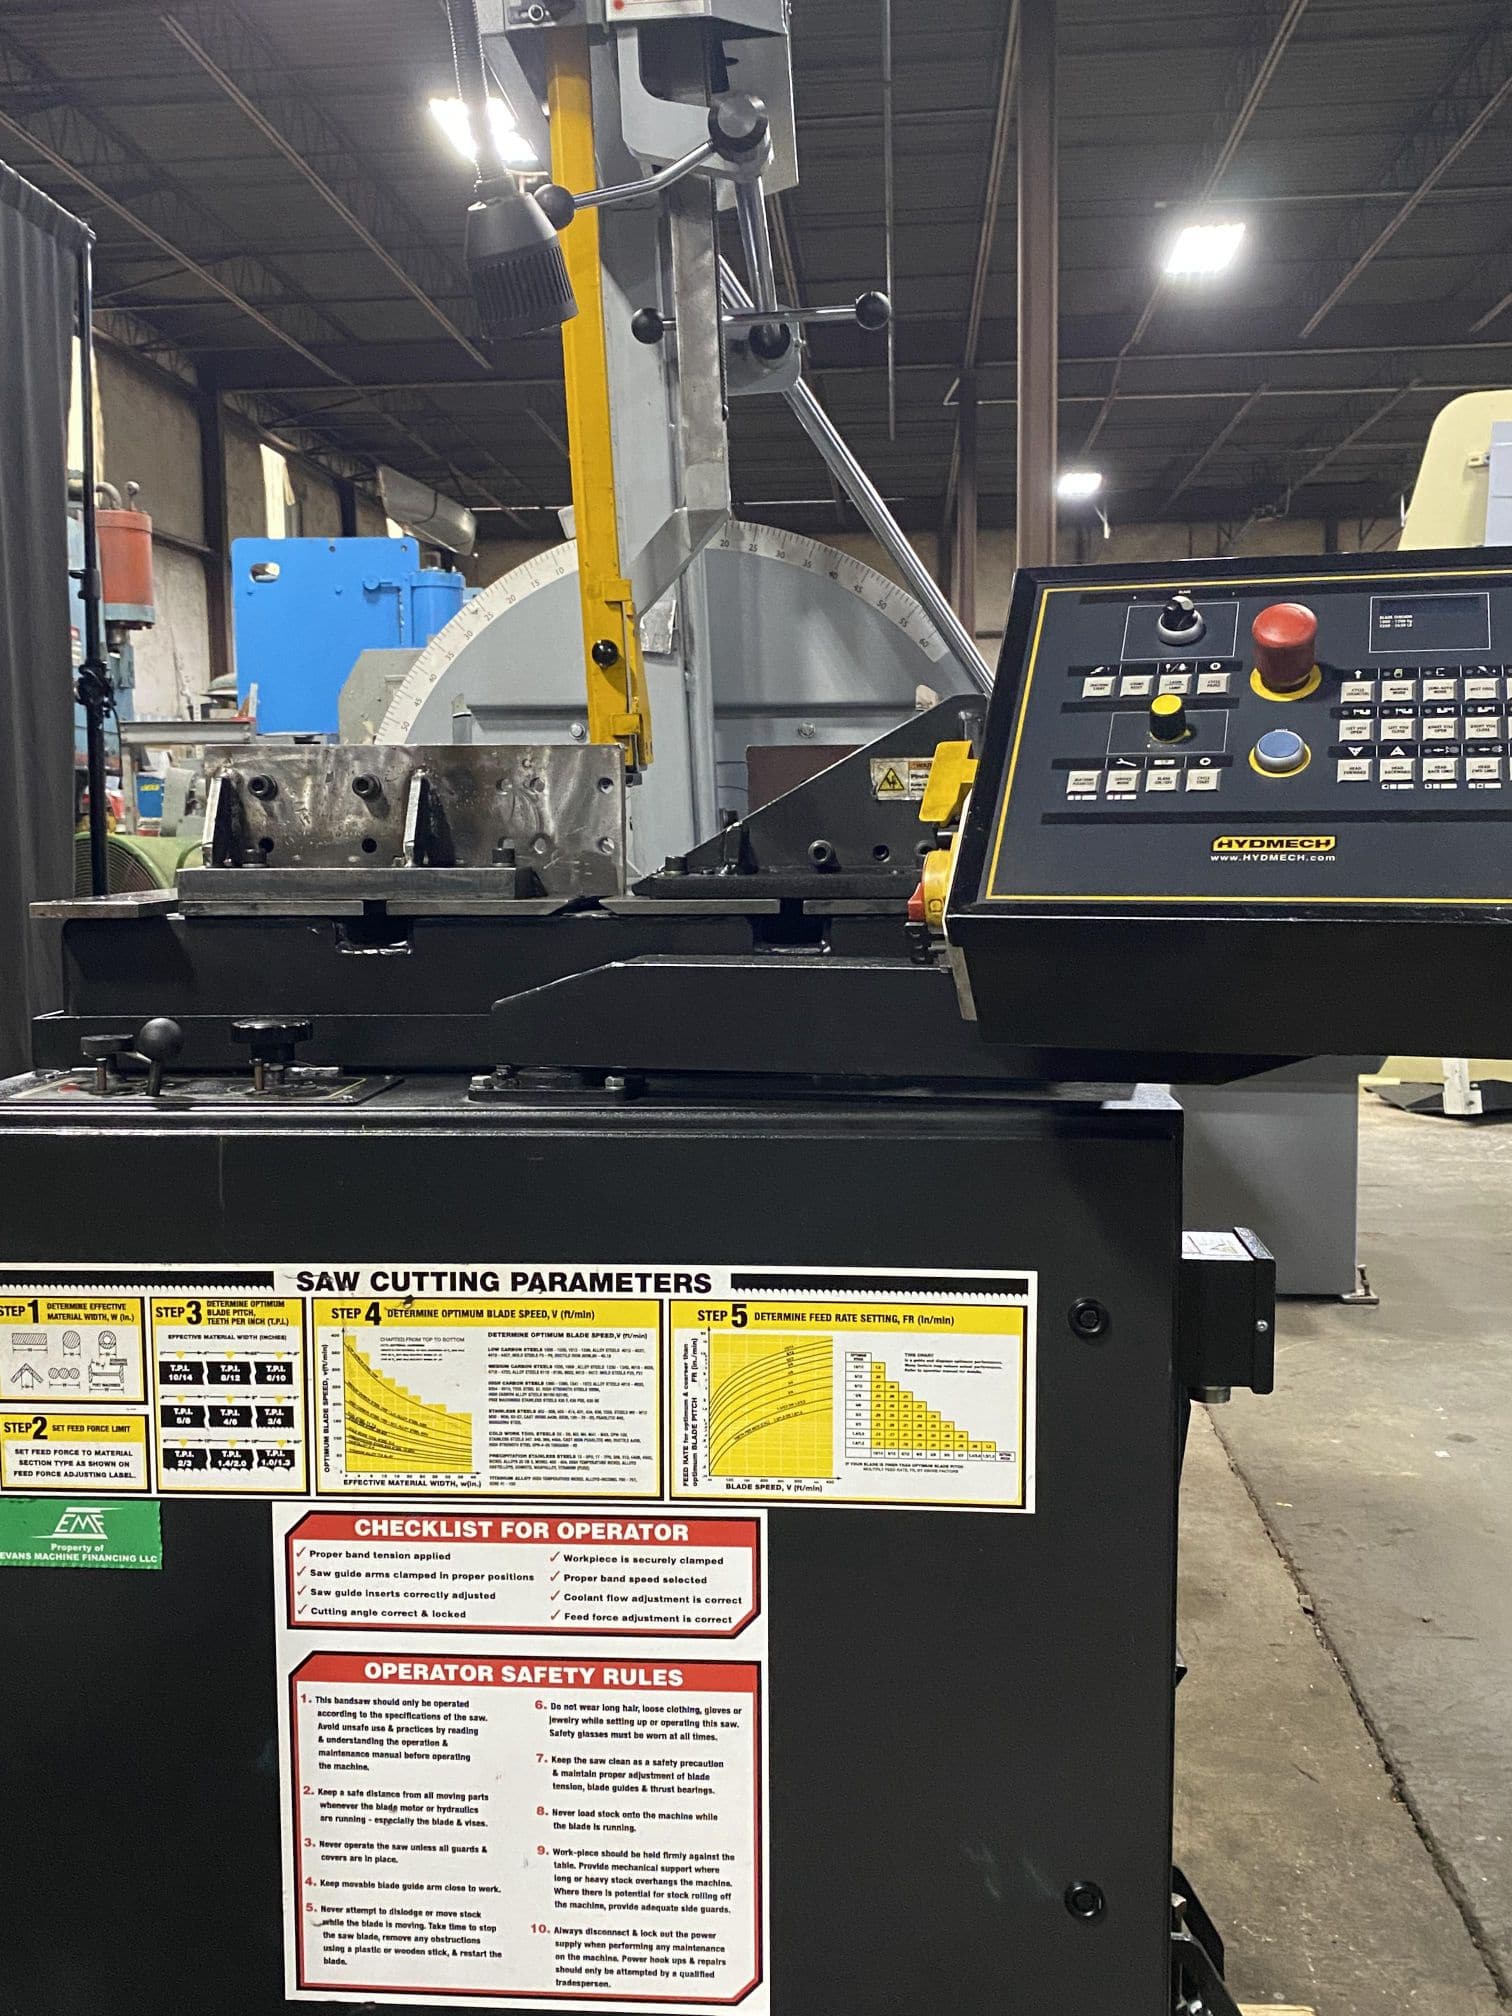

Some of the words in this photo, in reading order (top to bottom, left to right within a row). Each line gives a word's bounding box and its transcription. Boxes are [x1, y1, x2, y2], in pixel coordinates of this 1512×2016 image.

[776, 551, 785, 559] 30
[802, 560, 812, 569] 35
[556, 566, 565, 576] 10
[531, 579, 540, 588] 15
[853, 584, 863, 594] 45
[507, 594, 516, 604] 20
[877, 600, 887, 610] 50
[484, 612, 494, 622] 25
[464, 630, 473, 641] 30
[919, 638, 928, 648] 60
[401, 721, 410, 732] 50
[1217, 839, 1331, 848] HYDMECH
[295, 1271, 360, 1292] SAW
[370, 1271, 499, 1292] CUTTING
[510, 1271, 711, 1294] PARAMETERS
[27, 1299, 39, 1323] 1
[156, 1308, 185, 1318] STEP
[186, 1300, 202, 1325] 3
[232, 1309, 256, 1317] PITCH,
[332, 1308, 361, 1320] STEP
[364, 1302, 382, 1326] 4
[387, 1308, 438, 1317] DETERMINE
[441, 1309, 483, 1318] OPTIMUM
[486, 1309, 515, 1318] BLADE
[518, 1309, 549, 1320] SPEED,
[551, 1309, 557, 1318] V
[697, 1310, 727, 1322] STEP
[731, 1304, 748, 1327] 5
[83, 1313, 109, 1321] WIDTH,
[754, 1312, 806, 1321] DETERMINE
[809, 1312, 832, 1321] FEED
[835, 1313, 857, 1322] RATE
[860, 1313, 900, 1324] SETTING,
[902, 1314, 914, 1323] FR
[4, 1422, 32, 1433] STEP
[32, 1416, 48, 1440] 2
[354, 1519, 492, 1537] CHECKLIST
[501, 1521, 549, 1538] FOR
[557, 1522, 688, 1541] OPERATOR
[50, 1543, 91, 1553] Property
[0, 1552, 31, 1560] EVANS
[34, 1552, 79, 1560] MACHINE
[82, 1553, 136, 1562] FINANCING
[309, 1550, 342, 1558] Proper
[413, 1552, 450, 1561] applied
[563, 1554, 617, 1564] Workpiece
[632, 1556, 676, 1565] securely
[679, 1556, 723, 1566] clamped
[334, 1569, 361, 1578] guide
[393, 1571, 436, 1580] clamped
[439, 1571, 448, 1579] in
[487, 1572, 534, 1582] positions
[563, 1574, 597, 1583] Proper
[600, 1574, 625, 1582] band
[629, 1575, 659, 1584] speed
[662, 1575, 707, 1584] selected
[334, 1588, 362, 1597] guide
[365, 1589, 400, 1597] inserts
[403, 1591, 448, 1600] correctly
[452, 1591, 495, 1600] adjusted
[563, 1593, 603, 1601] Coolant
[606, 1594, 628, 1602] flow
[631, 1594, 689, 1604] adjustment
[310, 1607, 347, 1616] Cutting
[350, 1608, 377, 1617] angle
[432, 1609, 466, 1618] locked
[564, 1612, 589, 1620] Feed
[622, 1614, 679, 1623] adjustment
[364, 1662, 493, 1681] OPERATOR
[501, 1665, 595, 1684] SAFETY
[603, 1668, 683, 1686] RULES
[536, 1807, 549, 1816] 8.
[552, 1808, 575, 1816] Never
[577, 1809, 595, 1817] load
[658, 1812, 693, 1820] machine
[568, 1822, 591, 1830] blade
